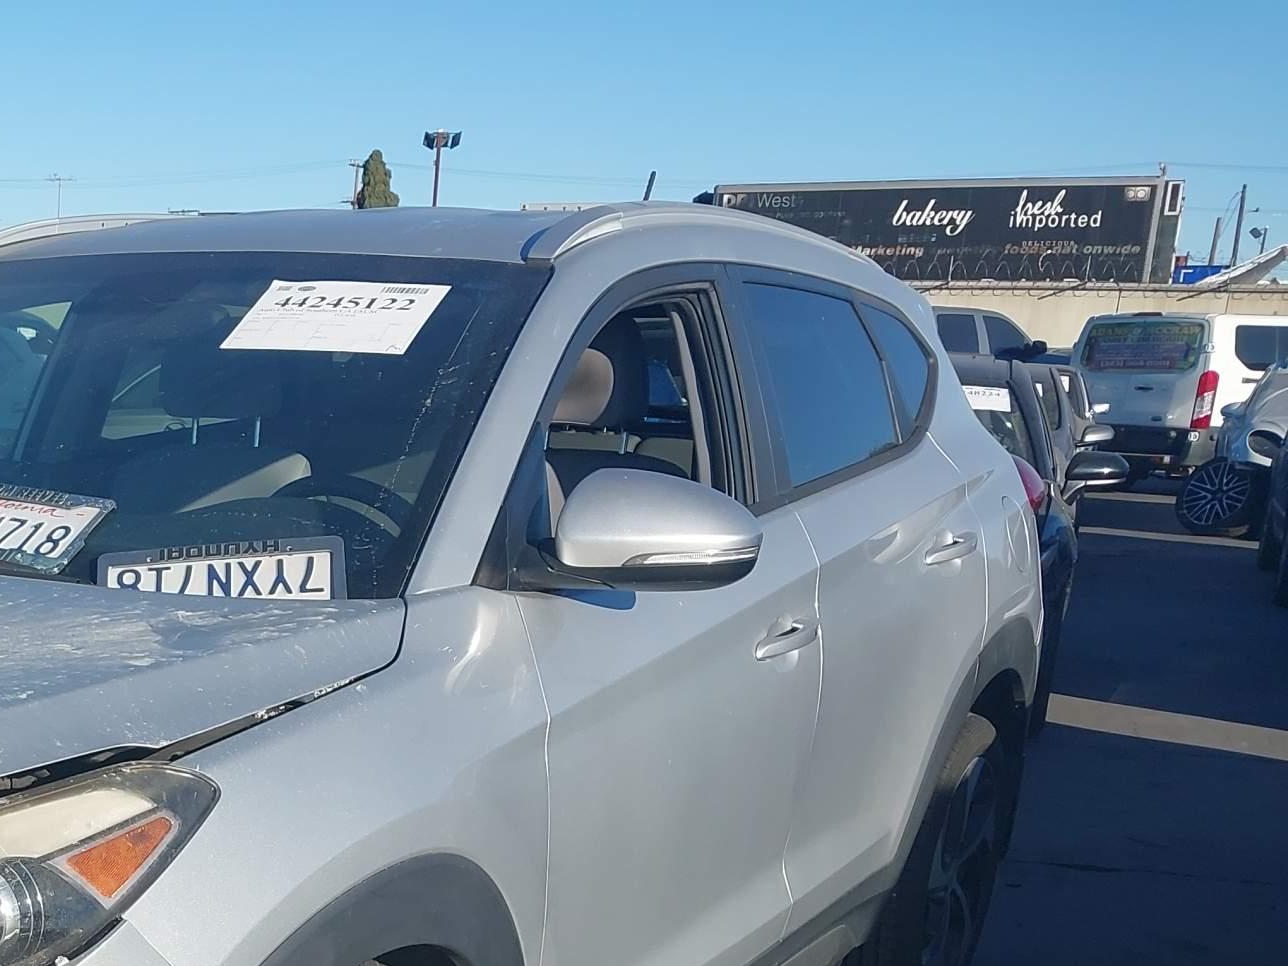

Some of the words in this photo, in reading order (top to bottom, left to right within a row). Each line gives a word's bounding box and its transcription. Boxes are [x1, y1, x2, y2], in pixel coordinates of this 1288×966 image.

[1016, 189, 1066, 221] fresh
[892, 198, 975, 236] bakery
[1009, 209, 1102, 232] imported
[274, 295, 417, 311] 44245122
[158, 539, 280, 561] HYUNDAI
